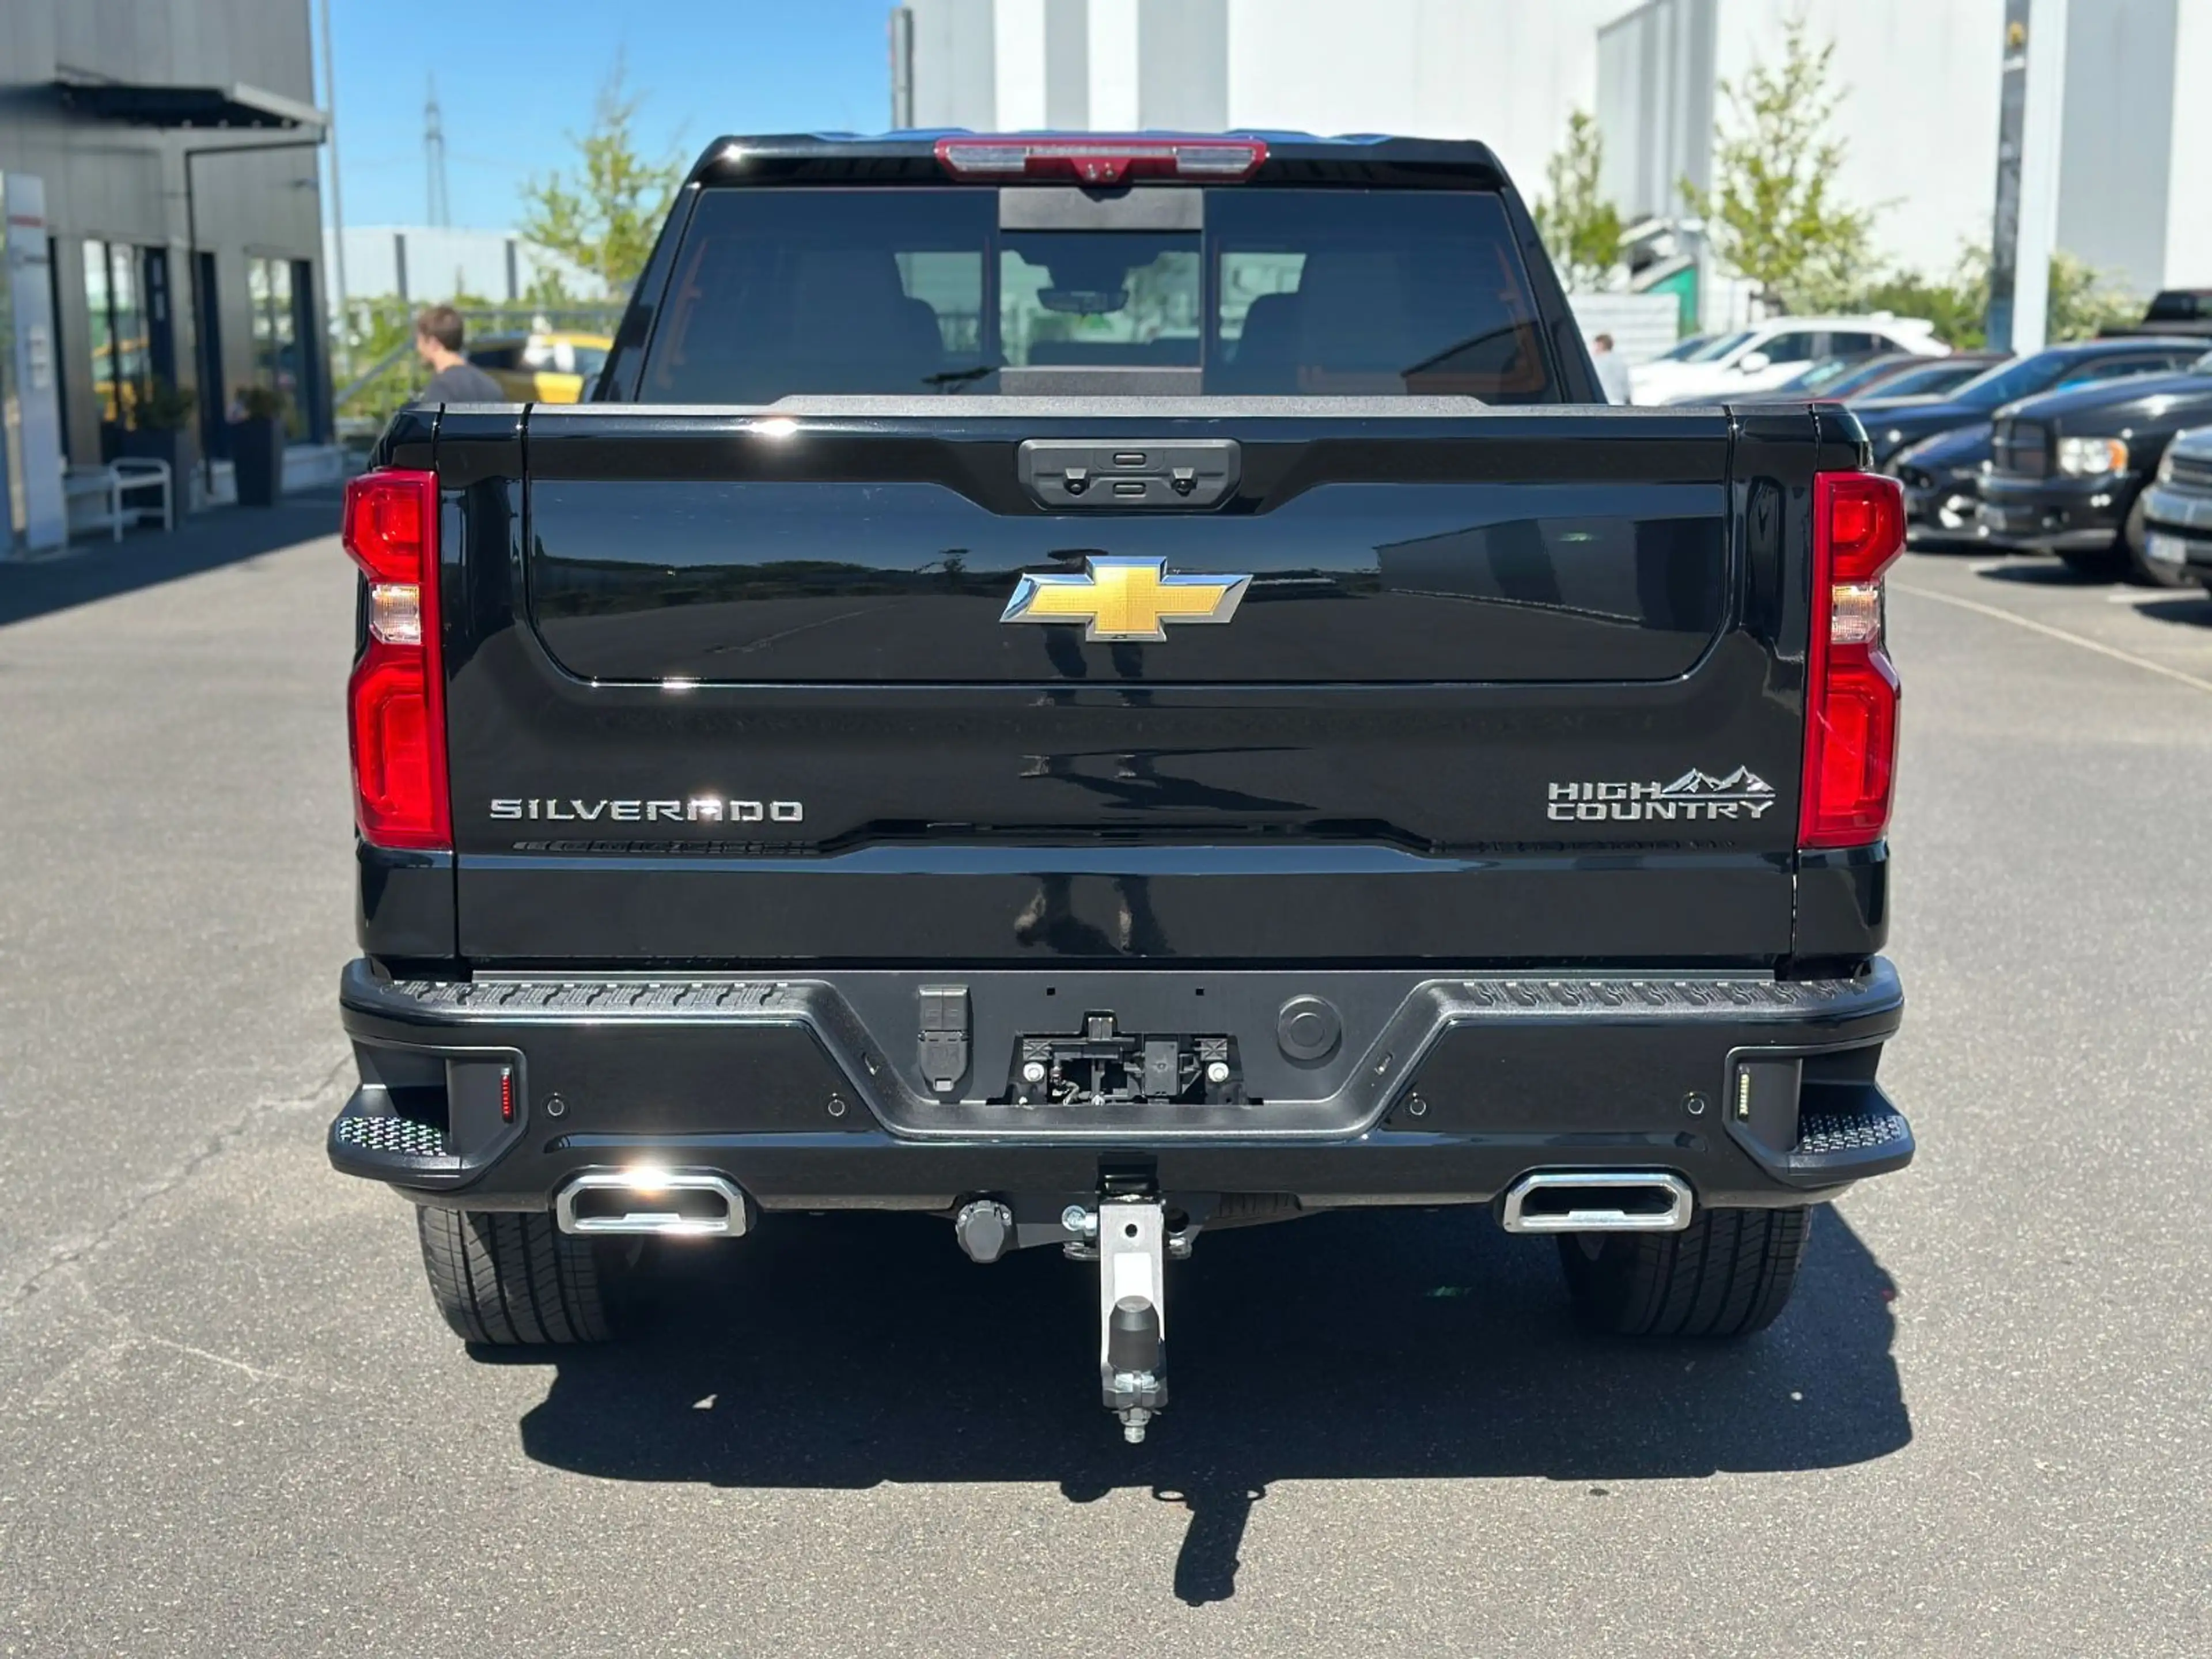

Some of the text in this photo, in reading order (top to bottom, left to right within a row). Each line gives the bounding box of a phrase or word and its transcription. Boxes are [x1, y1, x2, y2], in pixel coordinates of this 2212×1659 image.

[1548, 782, 1662, 800] HIGH
[490, 798, 804, 821] SILVERADO
[1547, 801, 1774, 820] COUNTRY
